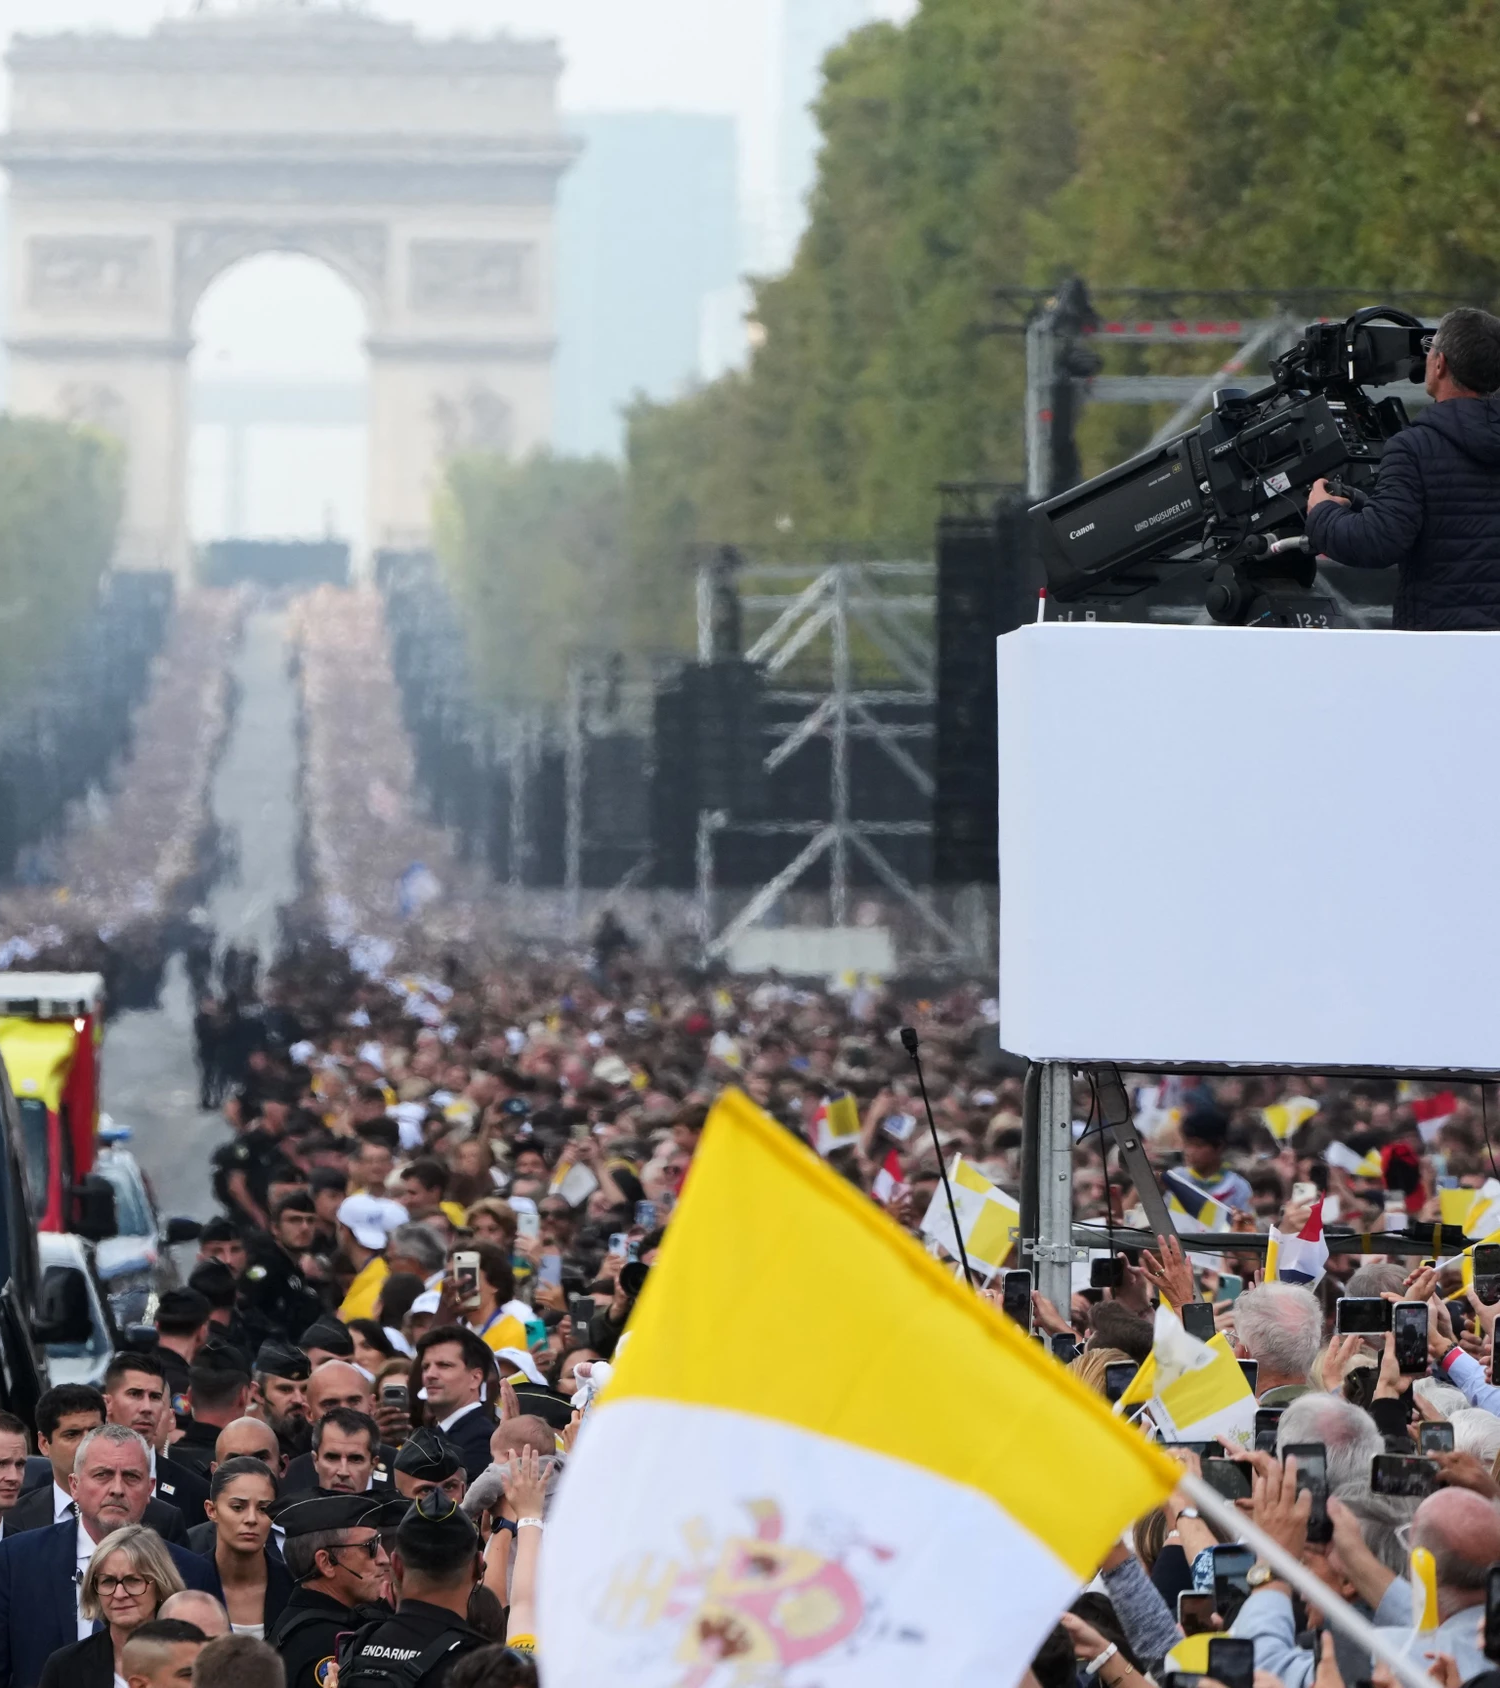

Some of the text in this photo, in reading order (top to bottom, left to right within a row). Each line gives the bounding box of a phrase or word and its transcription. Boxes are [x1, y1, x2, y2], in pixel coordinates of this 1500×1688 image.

[1214, 441, 1233, 455] SONY
[1134, 519, 1149, 532] UHD
[1148, 503, 1181, 526] DIGISUPER
[1180, 498, 1192, 510] 111
[1069, 522, 1095, 540] Canon
[361, 1645, 421, 1661] ENDARME
